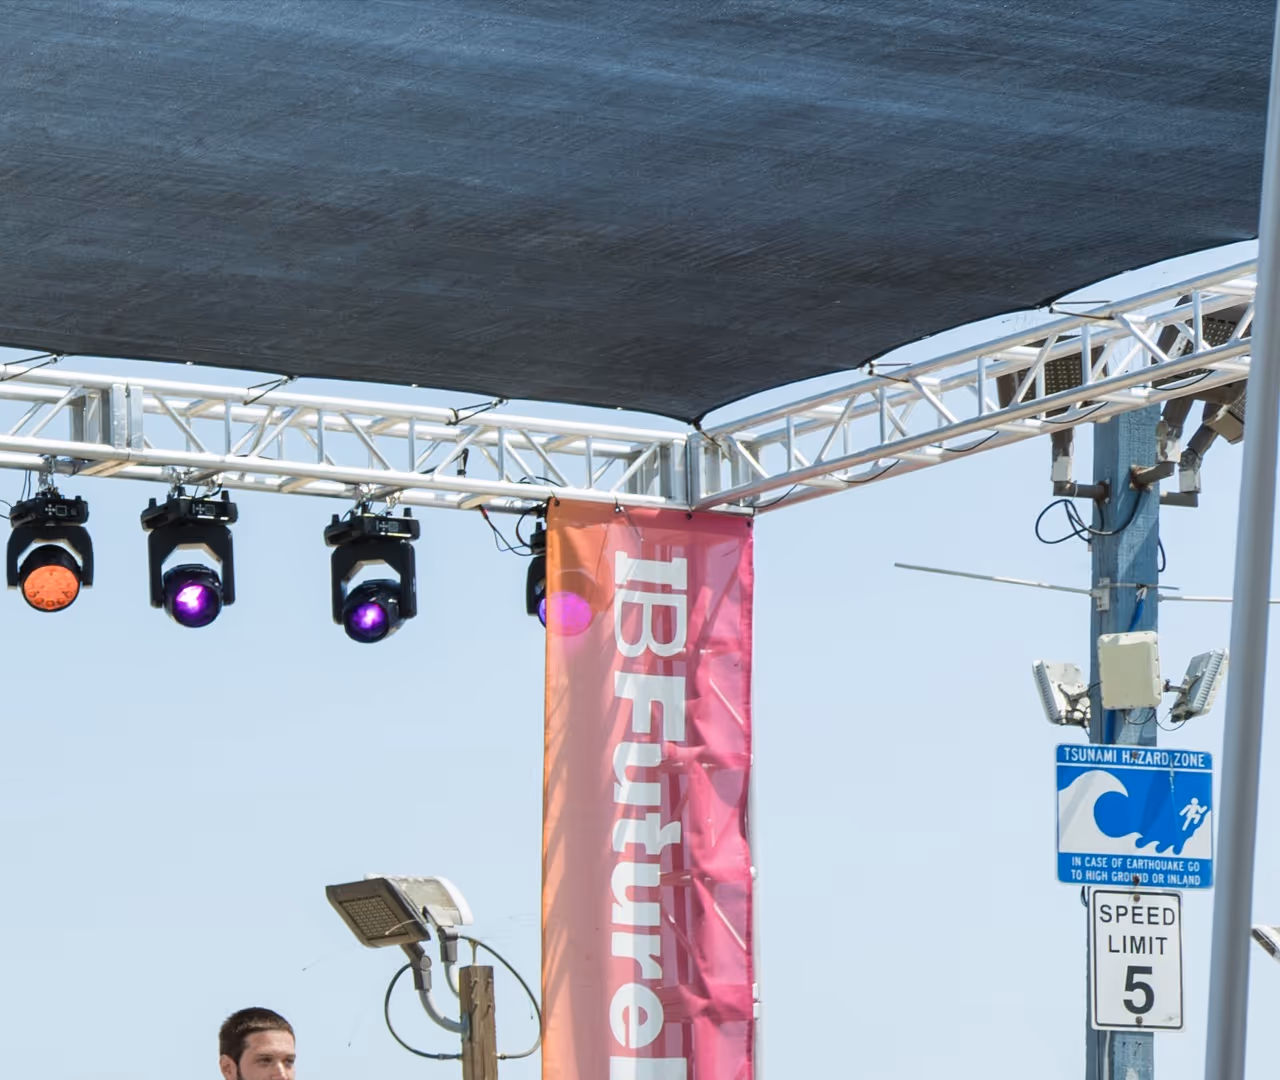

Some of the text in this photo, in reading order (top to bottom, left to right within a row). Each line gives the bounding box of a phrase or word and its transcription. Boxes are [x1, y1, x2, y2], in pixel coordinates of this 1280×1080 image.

[1064, 747, 1205, 768] TSUNAMI HAZARD ZONE
[1072, 856, 1200, 872] IN CASE OF EARTHQUAKE GO
[1071, 869, 1201, 885] TO HIGH GROUND OR INLAND
[1099, 904, 1175, 926] SPEED
[1108, 934, 1168, 955] LIMIT
[1122, 965, 1155, 1015] 5
